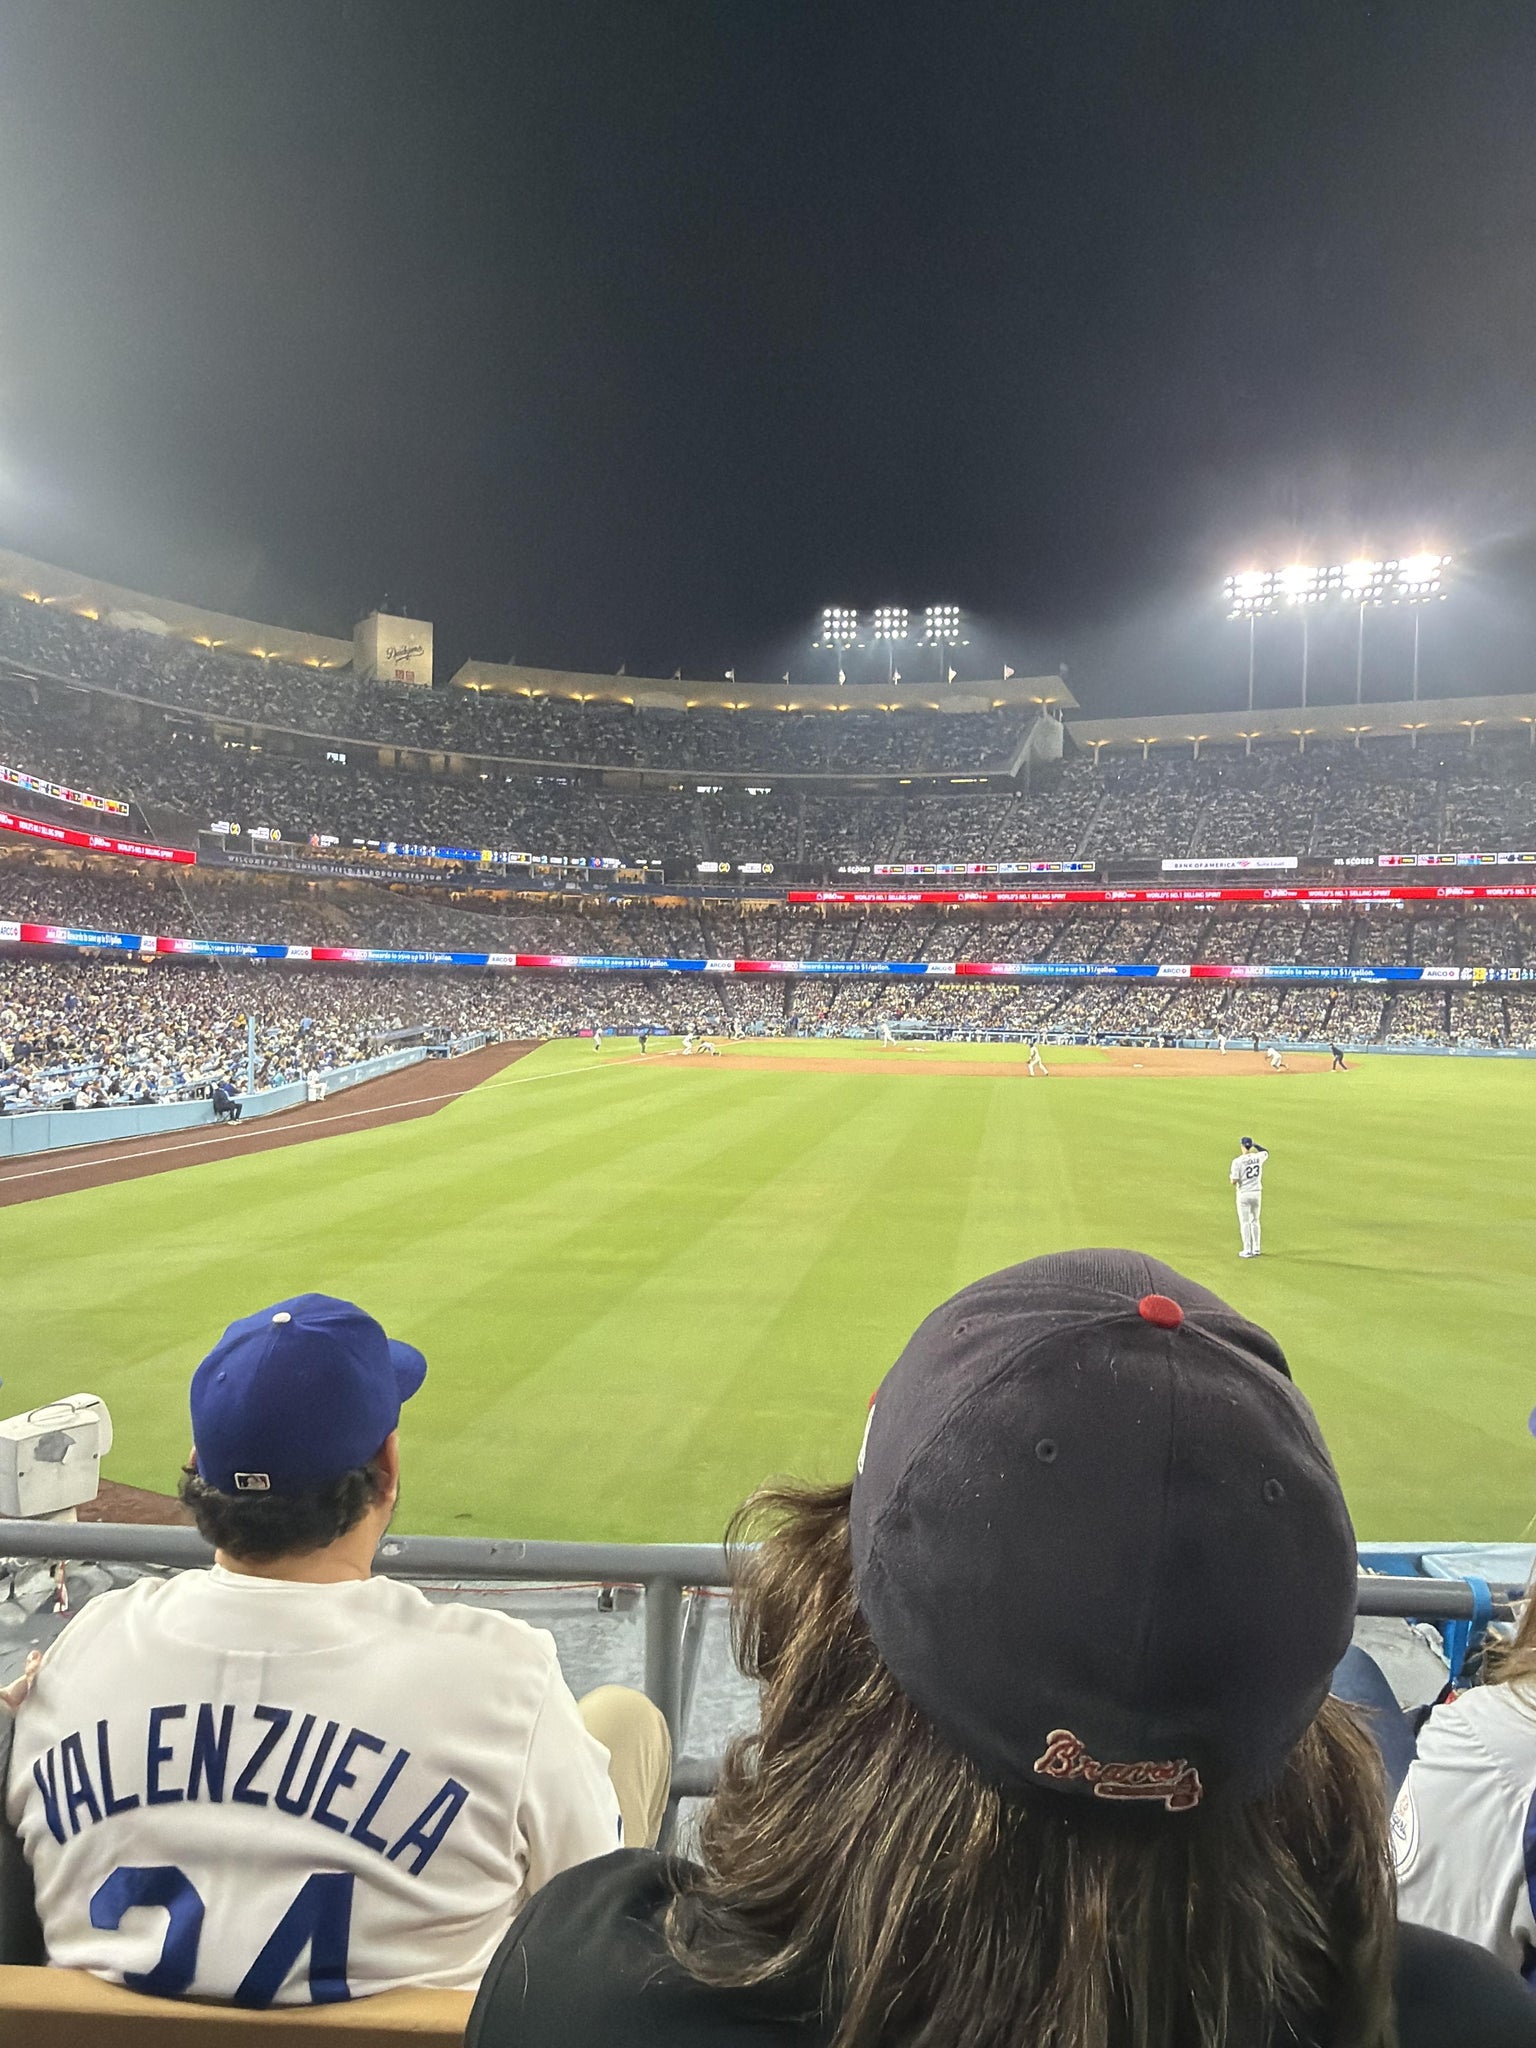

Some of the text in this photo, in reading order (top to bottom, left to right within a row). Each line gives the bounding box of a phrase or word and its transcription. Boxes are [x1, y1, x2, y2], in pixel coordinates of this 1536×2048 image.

[1245, 1165, 1260, 1179] 23
[1033, 1728, 1188, 1784] Braves
[33, 1703, 470, 1875] VALENZUELA
